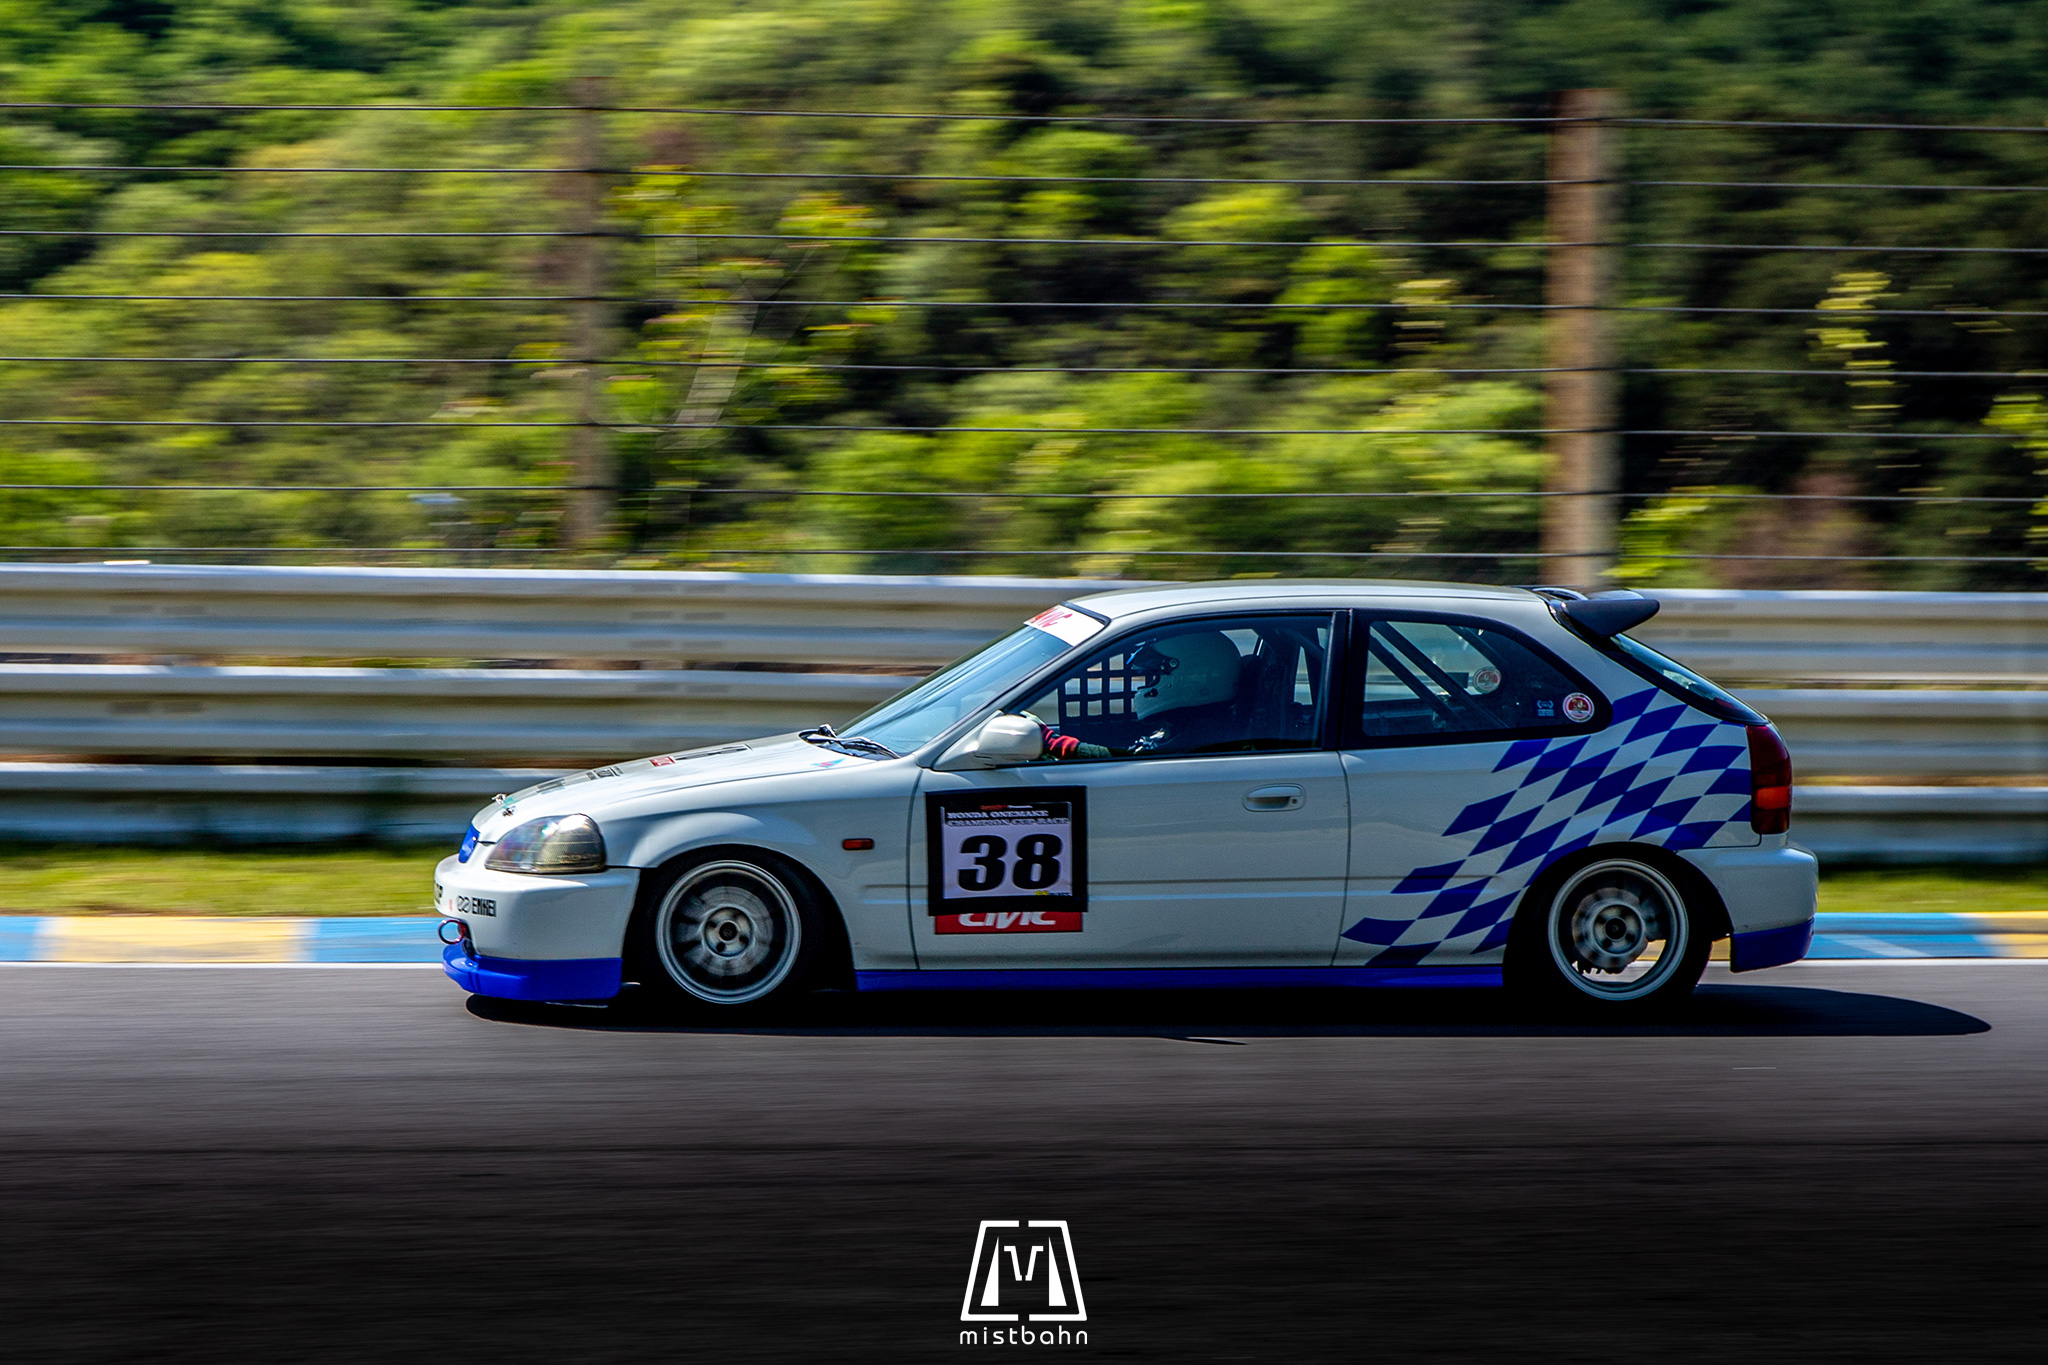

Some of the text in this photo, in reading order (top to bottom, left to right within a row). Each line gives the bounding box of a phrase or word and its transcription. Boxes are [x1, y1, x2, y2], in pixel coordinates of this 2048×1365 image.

[989, 810, 1049, 818] ONEMAKE
[947, 817, 1070, 827] CHAMPION CUP RACE
[958, 833, 1064, 891] 38
